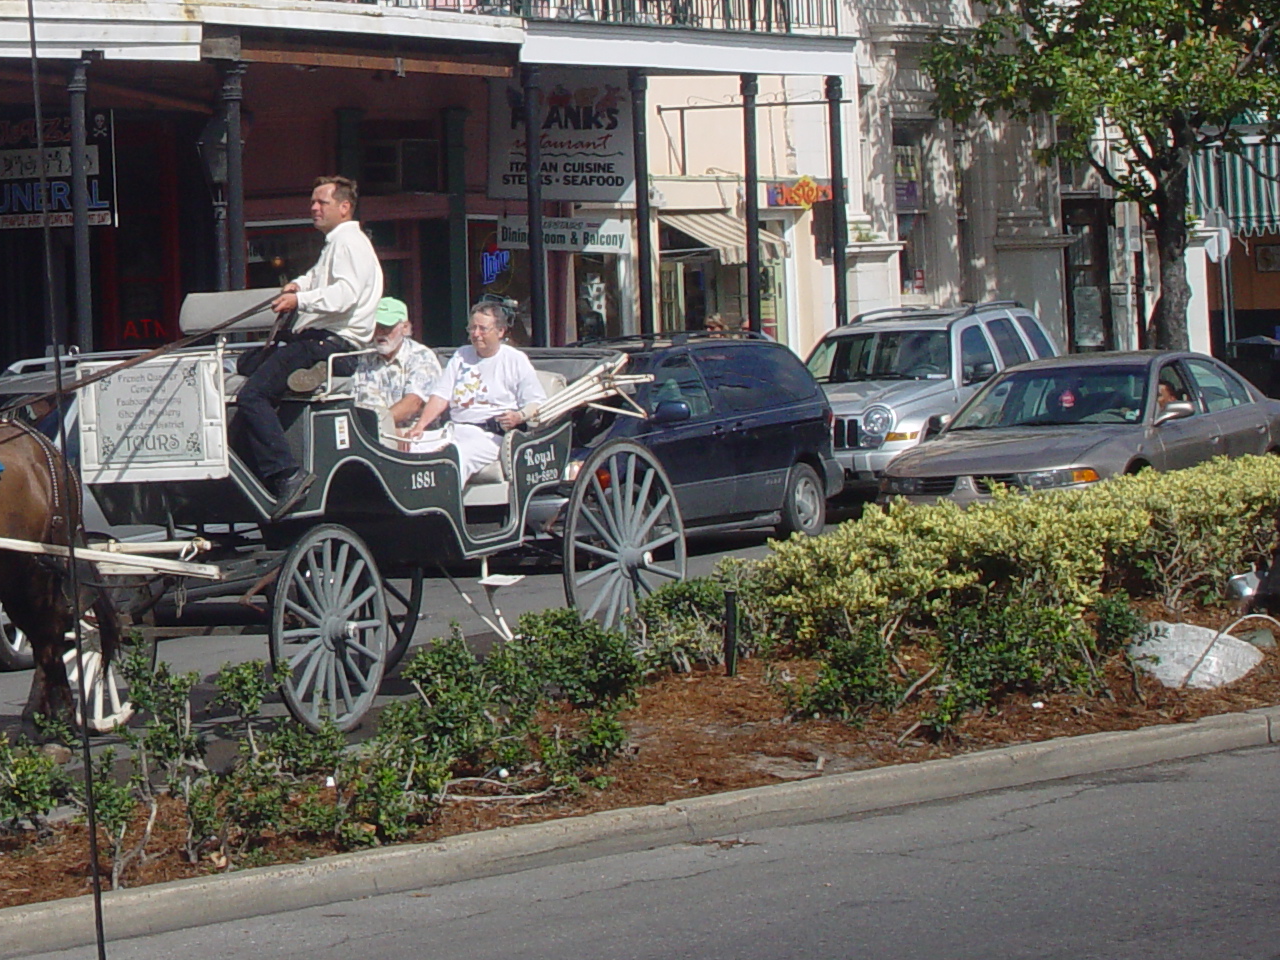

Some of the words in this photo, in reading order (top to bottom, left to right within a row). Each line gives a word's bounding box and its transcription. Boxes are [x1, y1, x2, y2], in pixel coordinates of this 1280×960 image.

[509, 161, 559, 173] ITAAN
[563, 162, 616, 173] CUISINE
[502, 174, 553, 186] STES
[563, 175, 625, 187] SEAFOOD
[501, 225, 529, 243] Dinin
[542, 232, 566, 245] oom
[570, 231, 579, 244] &
[582, 231, 626, 249] Balcony
[147, 372, 178, 382] Quaer
[123, 433, 181, 452] TOURS
[524, 444, 556, 469] Royal
[411, 471, 437, 490] 1881
